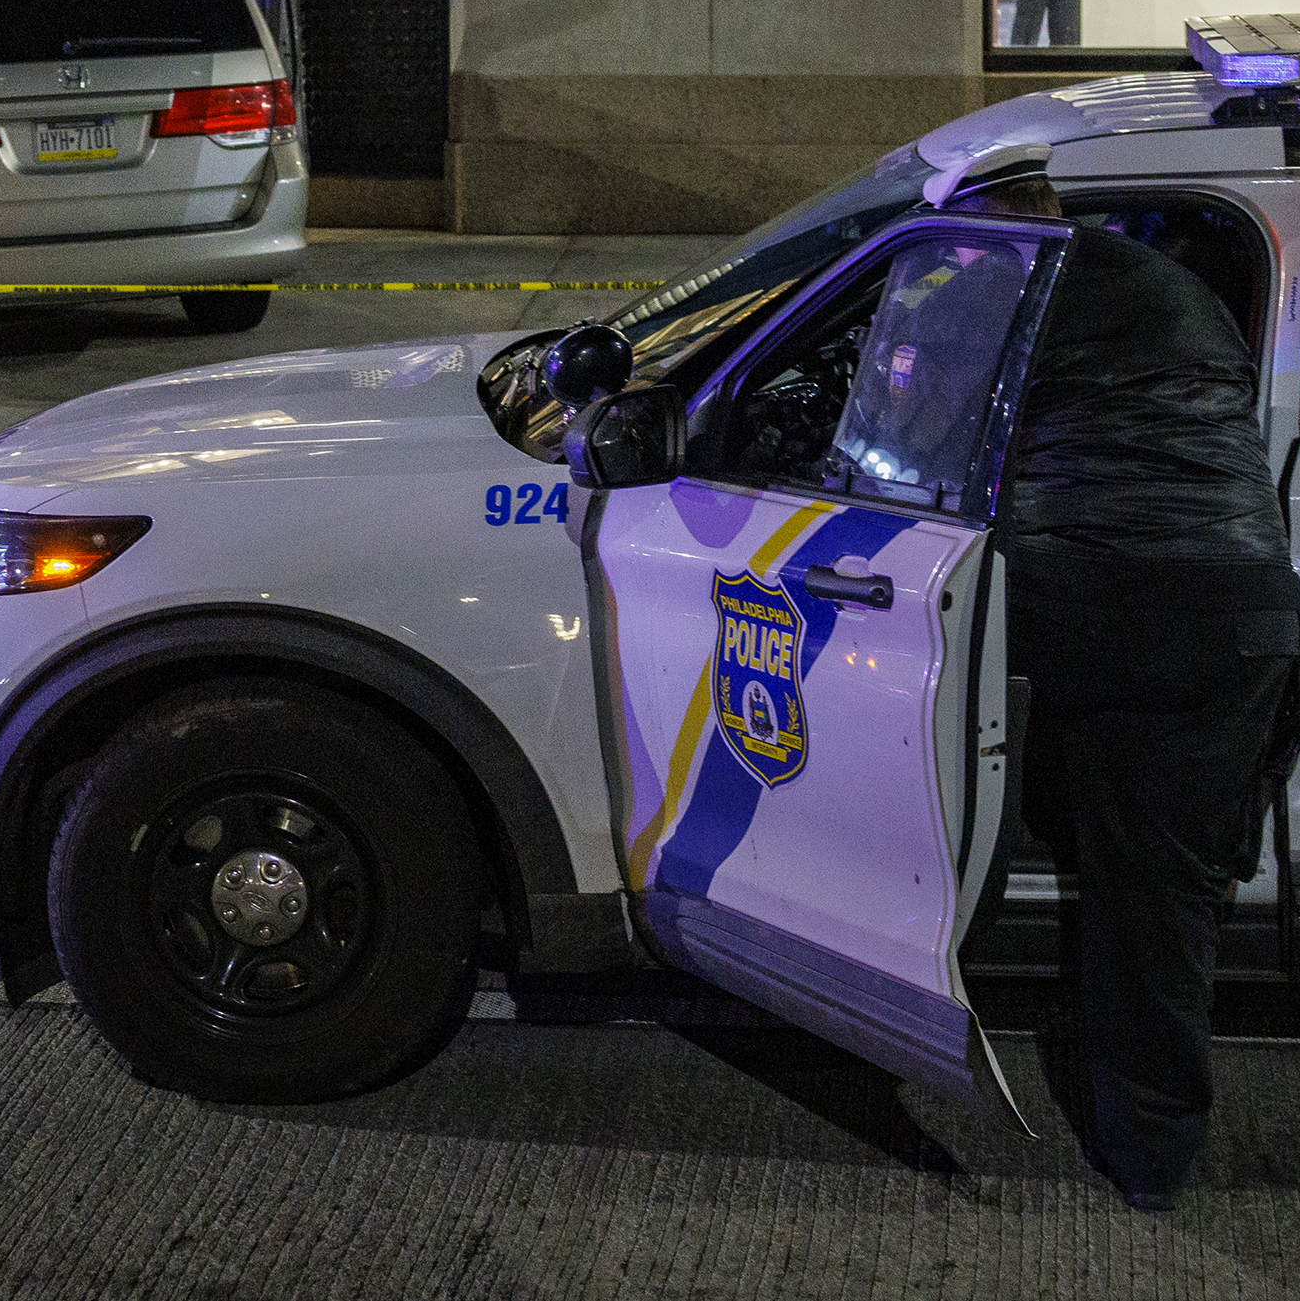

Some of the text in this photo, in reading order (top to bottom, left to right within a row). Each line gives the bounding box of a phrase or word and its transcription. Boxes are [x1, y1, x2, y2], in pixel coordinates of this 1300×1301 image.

[485, 483, 569, 526] 924
[720, 594, 794, 627] PHILADELPHIA
[724, 616, 794, 681] POLICE
